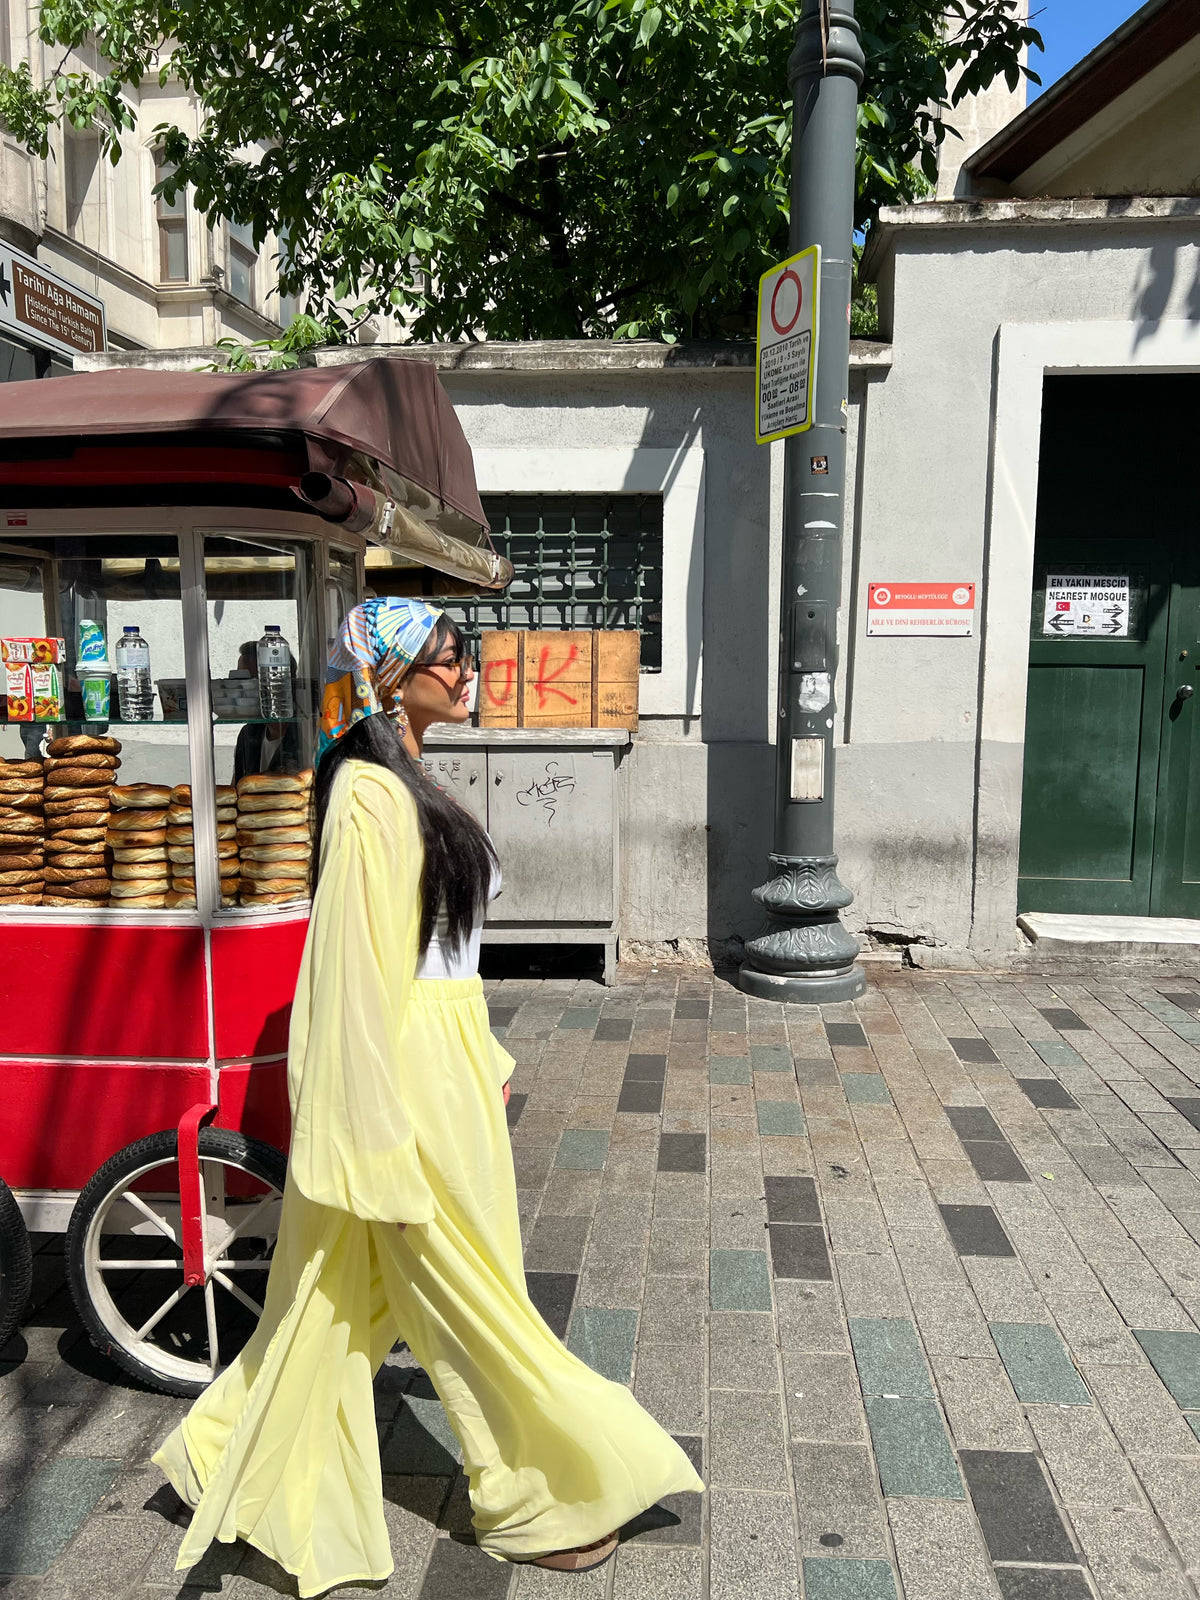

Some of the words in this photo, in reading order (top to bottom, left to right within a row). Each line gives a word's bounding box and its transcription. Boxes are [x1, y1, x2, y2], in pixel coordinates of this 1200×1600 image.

[16, 267, 45, 295] Tarihi
[47, 285, 64, 306] Ağa
[66, 294, 100, 326] Hamamı
[28, 295, 57, 318] Historical
[58, 311, 82, 330] Turkish
[30, 309, 48, 326] Since
[49, 318, 60, 332] The
[70, 330, 92, 350] Century
[764, 366, 782, 379] UKOME
[762, 391, 771, 403] 00
[789, 381, 799, 394] 08
[1052, 578, 1062, 587] EN
[1066, 578, 1090, 588] YAKIN
[1048, 592, 1088, 600] NEAREST
[1090, 592, 1127, 601] MOSQUE
